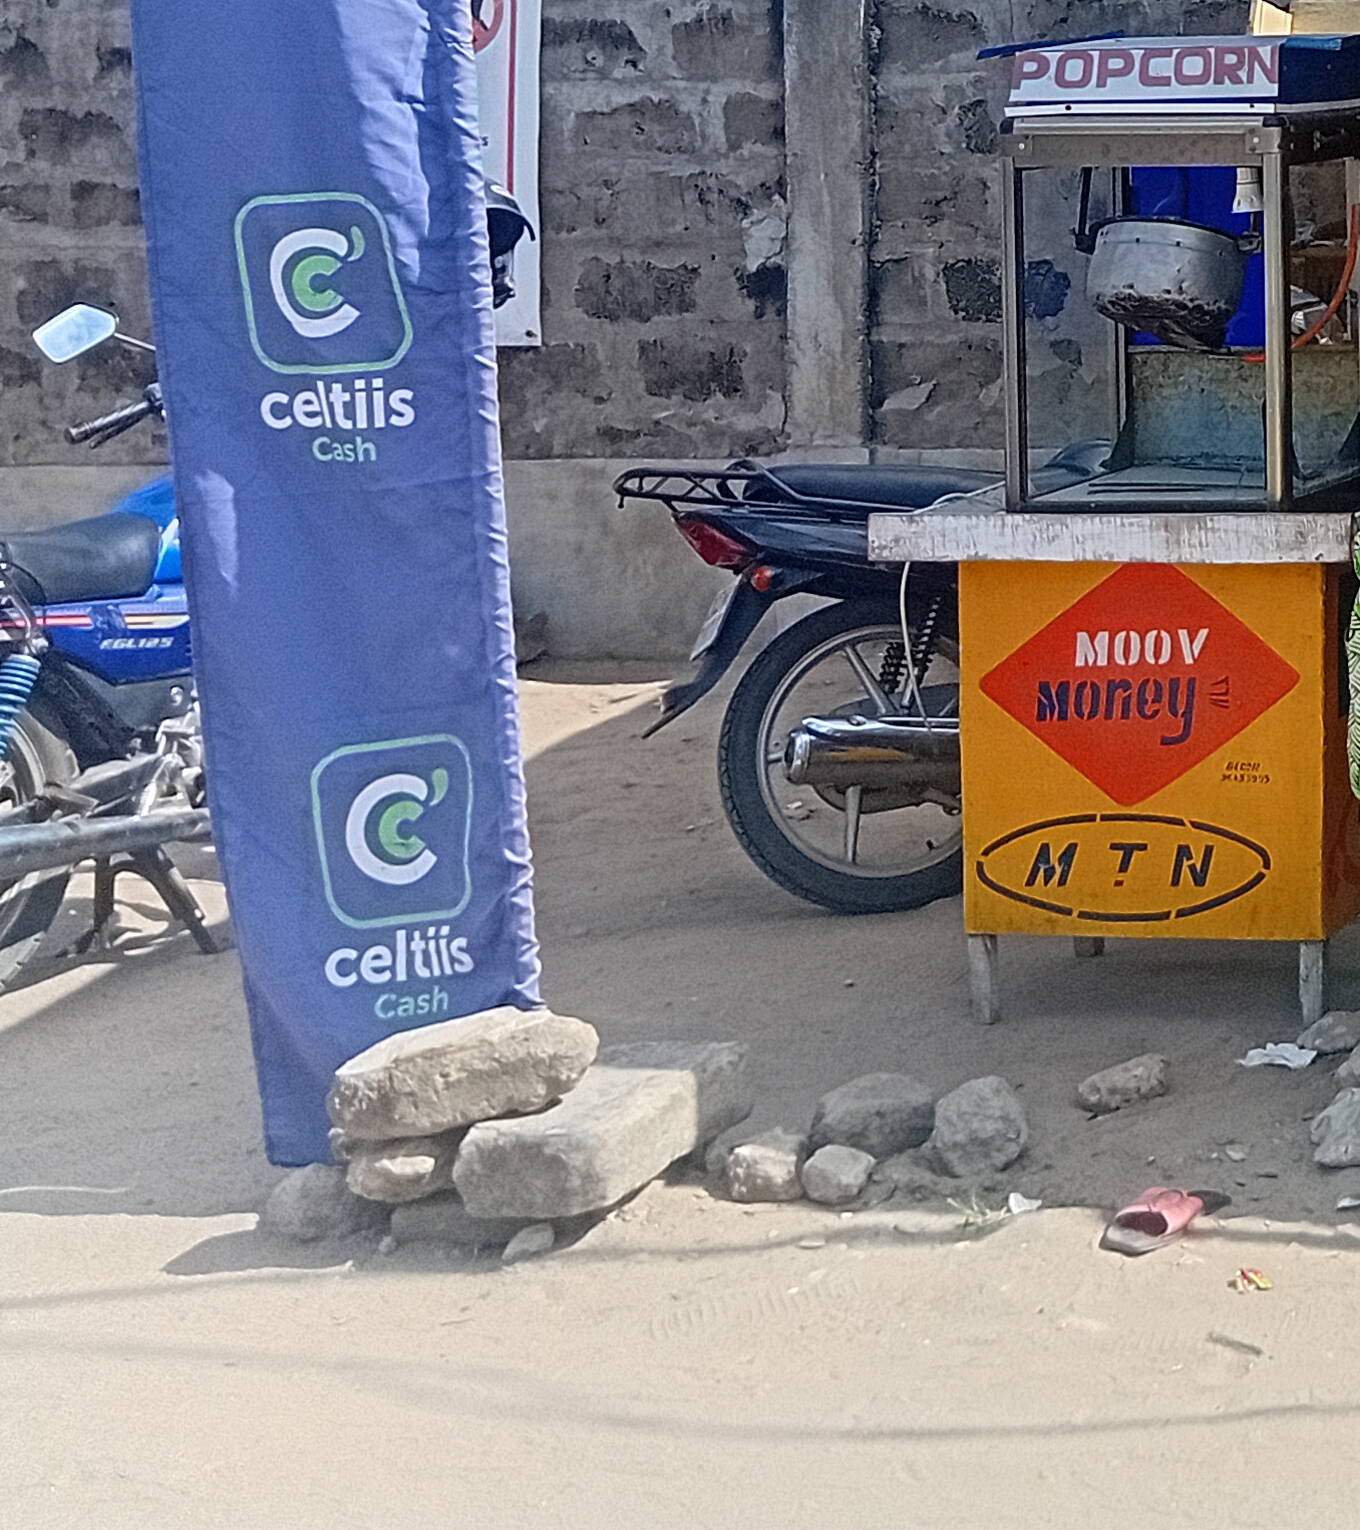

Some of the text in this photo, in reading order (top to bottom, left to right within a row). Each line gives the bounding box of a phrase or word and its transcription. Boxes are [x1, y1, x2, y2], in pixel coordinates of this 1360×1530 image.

[1011, 46, 1280, 91] POPCORN
[261, 378, 415, 430] celtiis
[312, 436, 377, 462] Cash
[1075, 628, 1209, 667] MOOV
[1036, 676, 1197, 746] Money
[325, 925, 475, 987] celtiis
[374, 986, 449, 1019] Cash
